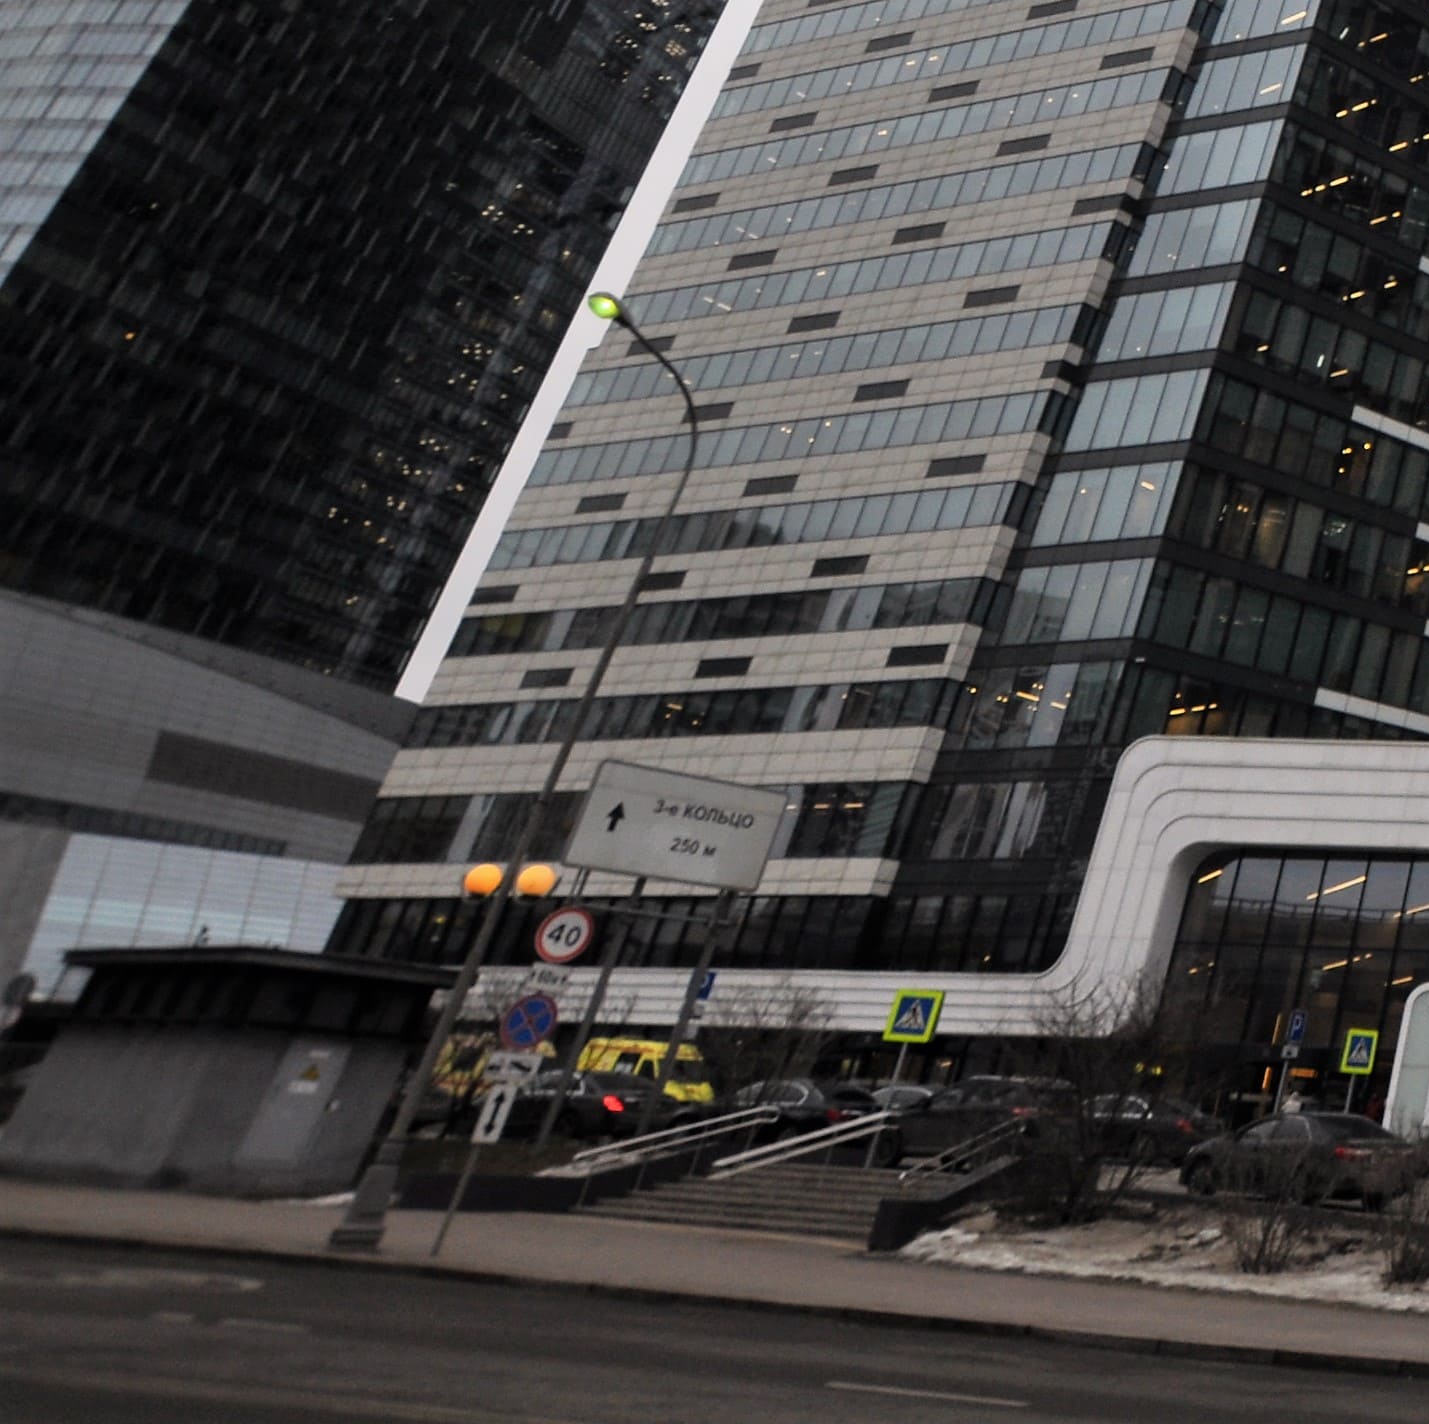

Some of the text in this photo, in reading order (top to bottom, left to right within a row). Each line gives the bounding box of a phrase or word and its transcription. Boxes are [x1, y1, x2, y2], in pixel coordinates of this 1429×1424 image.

[682, 804, 754, 829] КОЛЬЦО
[670, 837, 700, 855] 250
[548, 924, 581, 947] 40
